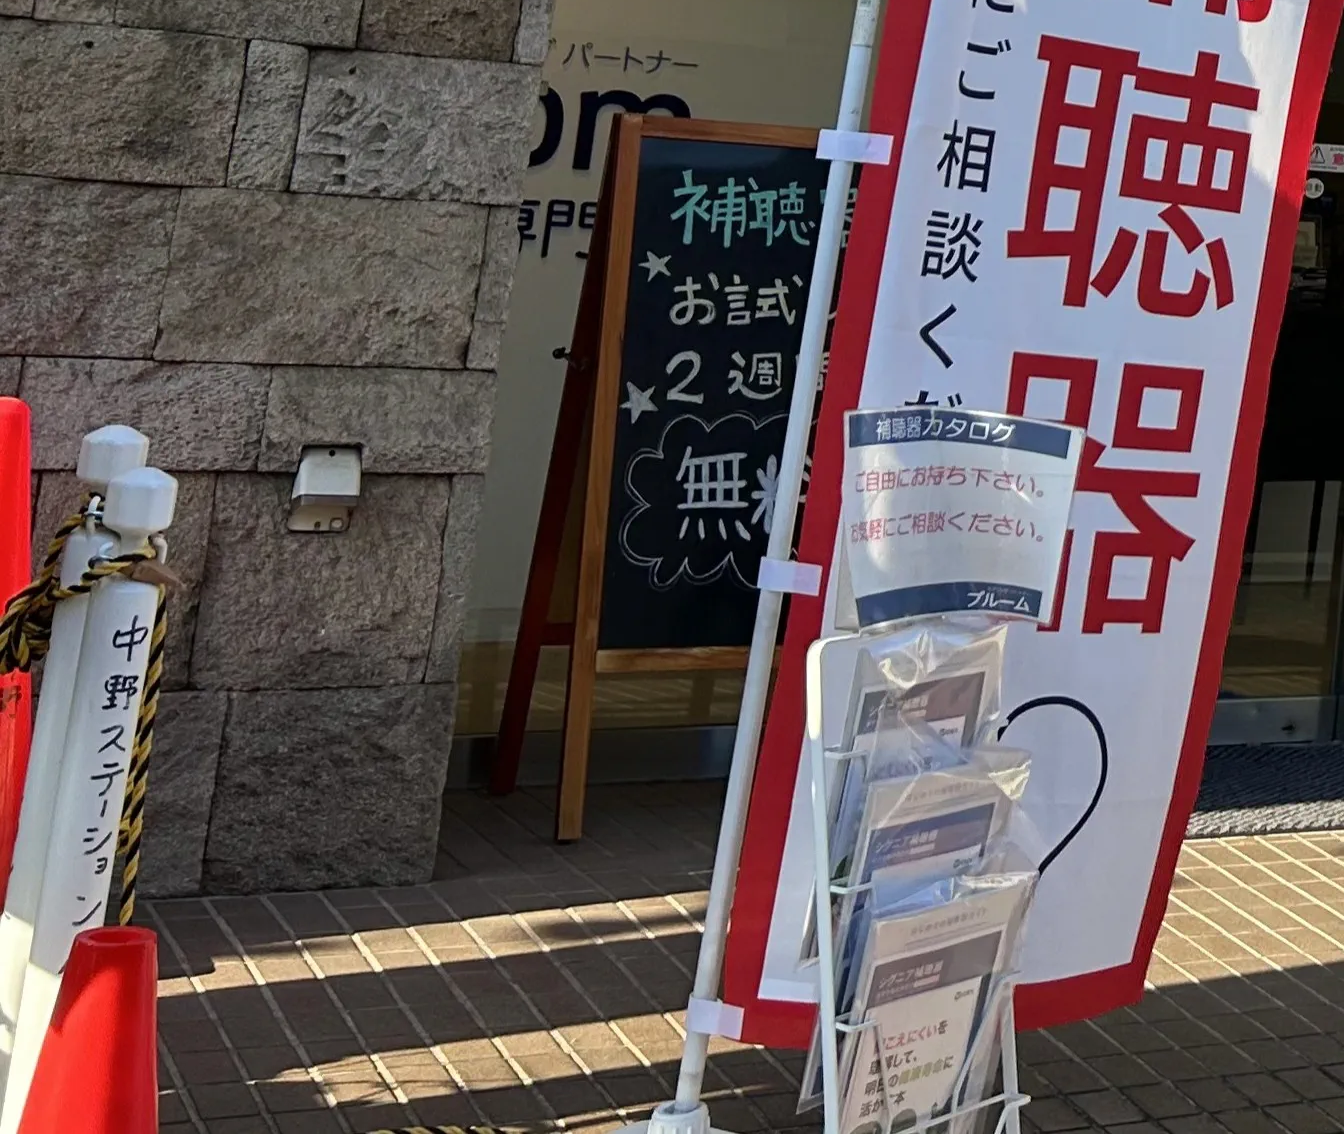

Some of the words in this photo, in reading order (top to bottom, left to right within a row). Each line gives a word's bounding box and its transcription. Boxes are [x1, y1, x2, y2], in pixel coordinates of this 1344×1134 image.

[562, 41, 700, 74] パートナー
[875, 417, 1017, 443] 補聴器カタログ
[855, 465, 1045, 499] ご自由にお持ち下さい。
[851, 511, 1045, 544] お気軽にご相談ください。
[966, 590, 1031, 613] ブルーム
[71, 614, 149, 927] 中野ステーション
